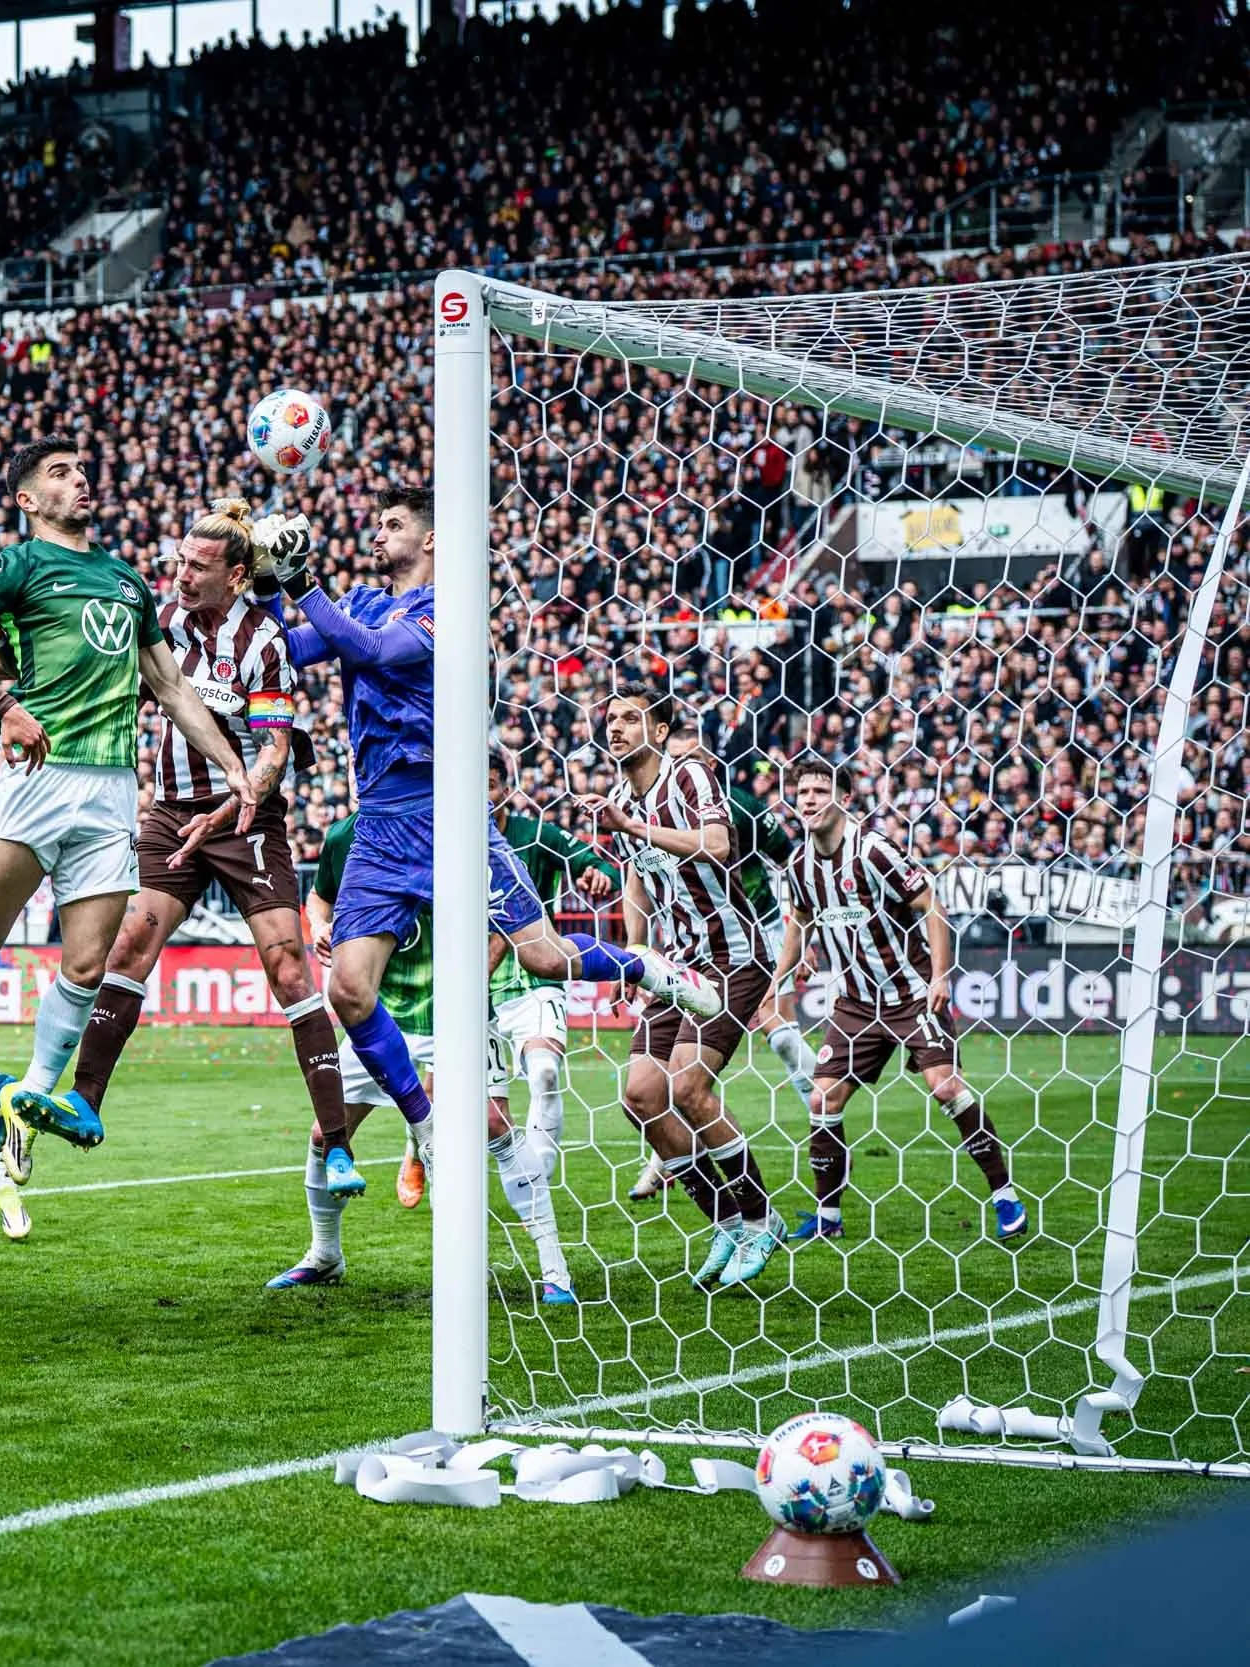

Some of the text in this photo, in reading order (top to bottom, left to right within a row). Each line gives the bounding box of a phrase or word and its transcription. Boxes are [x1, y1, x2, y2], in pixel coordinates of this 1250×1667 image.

[246, 833, 265, 871] 7
[90, 1007, 117, 1020] AULI
[916, 1012, 944, 1041] 11
[488, 1038, 506, 1072] 2
